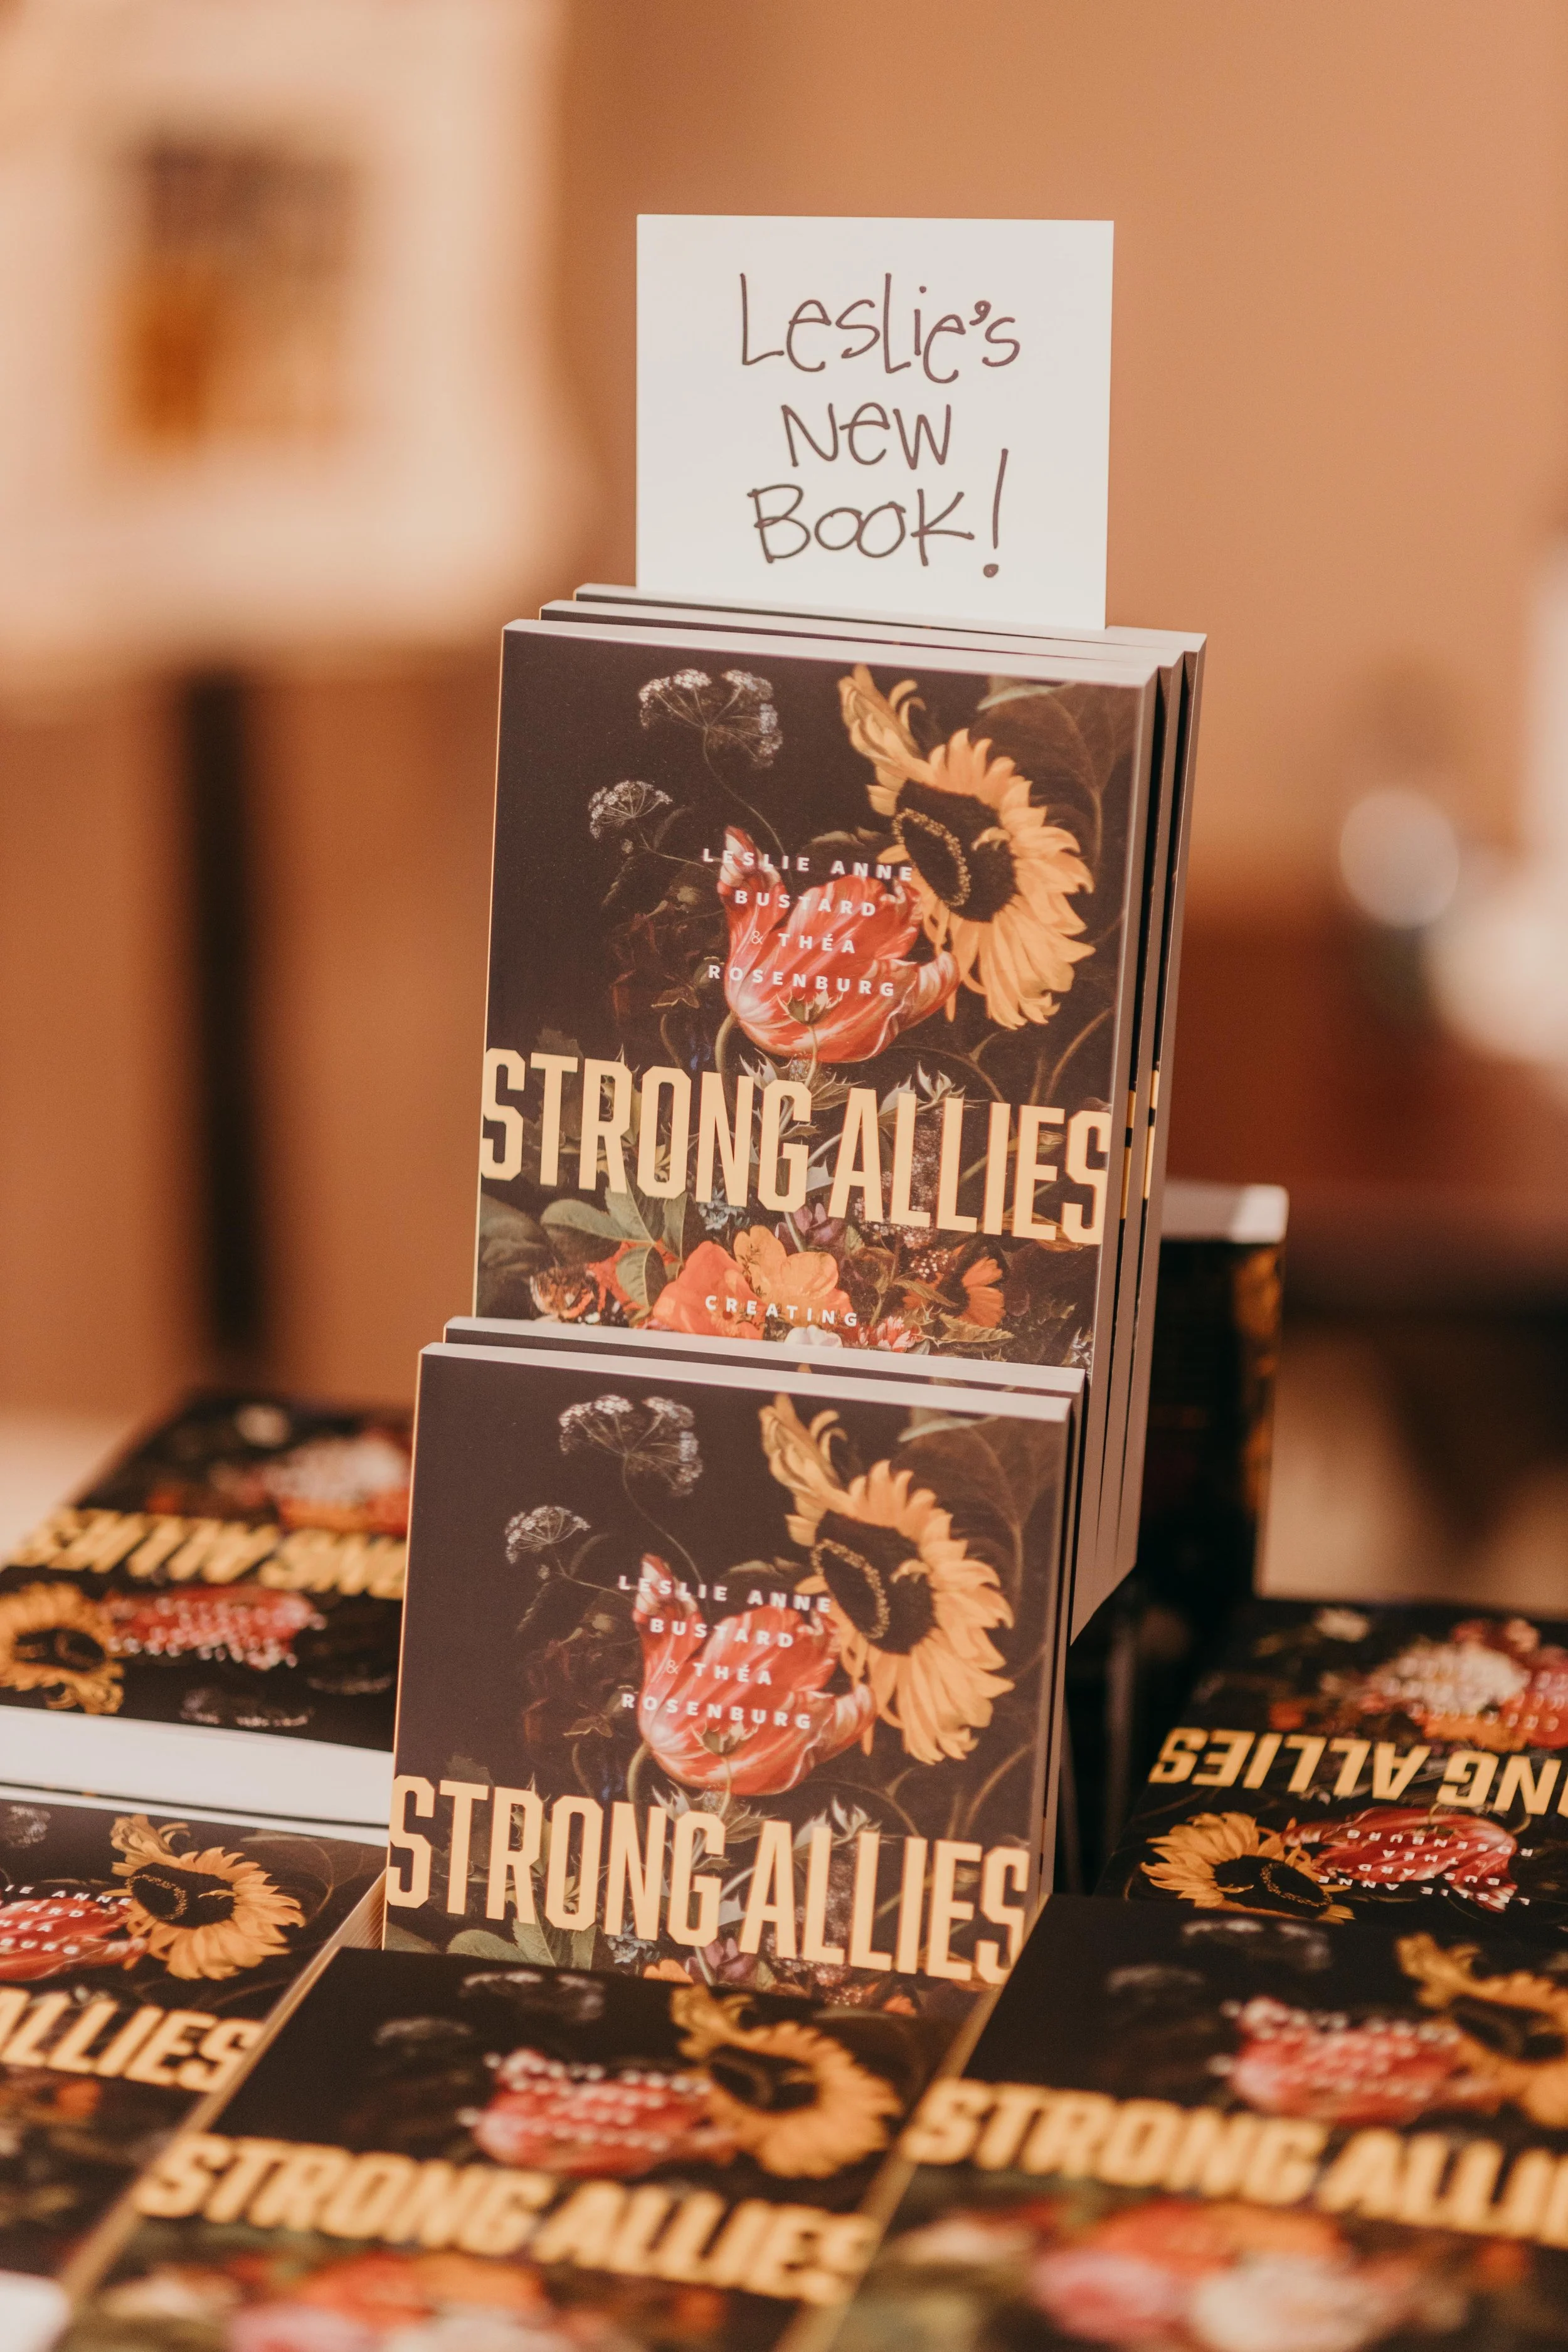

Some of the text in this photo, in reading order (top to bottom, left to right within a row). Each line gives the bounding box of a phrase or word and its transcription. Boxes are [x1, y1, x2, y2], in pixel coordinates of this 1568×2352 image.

[702, 848, 913, 881] LESLIE ANNE
[735, 890, 876, 917] BUSTARD
[751, 930, 856, 954] & THÉA
[708, 965, 894, 997] ROSENBURG
[480, 1047, 1111, 1244] STRONG ALLIES
[705, 1295, 857, 1327] CREATING
[618, 1576, 831, 1613] LESLIE ANNE
[650, 1618, 793, 1648] BUSTARD
[694, 1662, 772, 1685] THÉA
[622, 1693, 811, 1730] ROSENBURG
[1148, 1727, 1431, 1801] ALLIES
[1347, 1830, 1534, 1857] ROSENBURG
[387, 1776, 1030, 1984] STRONG ALLIES
[1317, 1875, 1530, 1906] LESLIE ANNE
[1358, 1863, 1500, 1886] BUSTARD
[51, 1890, 132, 1905] ANNE
[901, 2076, 1325, 2204] STRONG
[133, 2132, 551, 2255] STRONG
